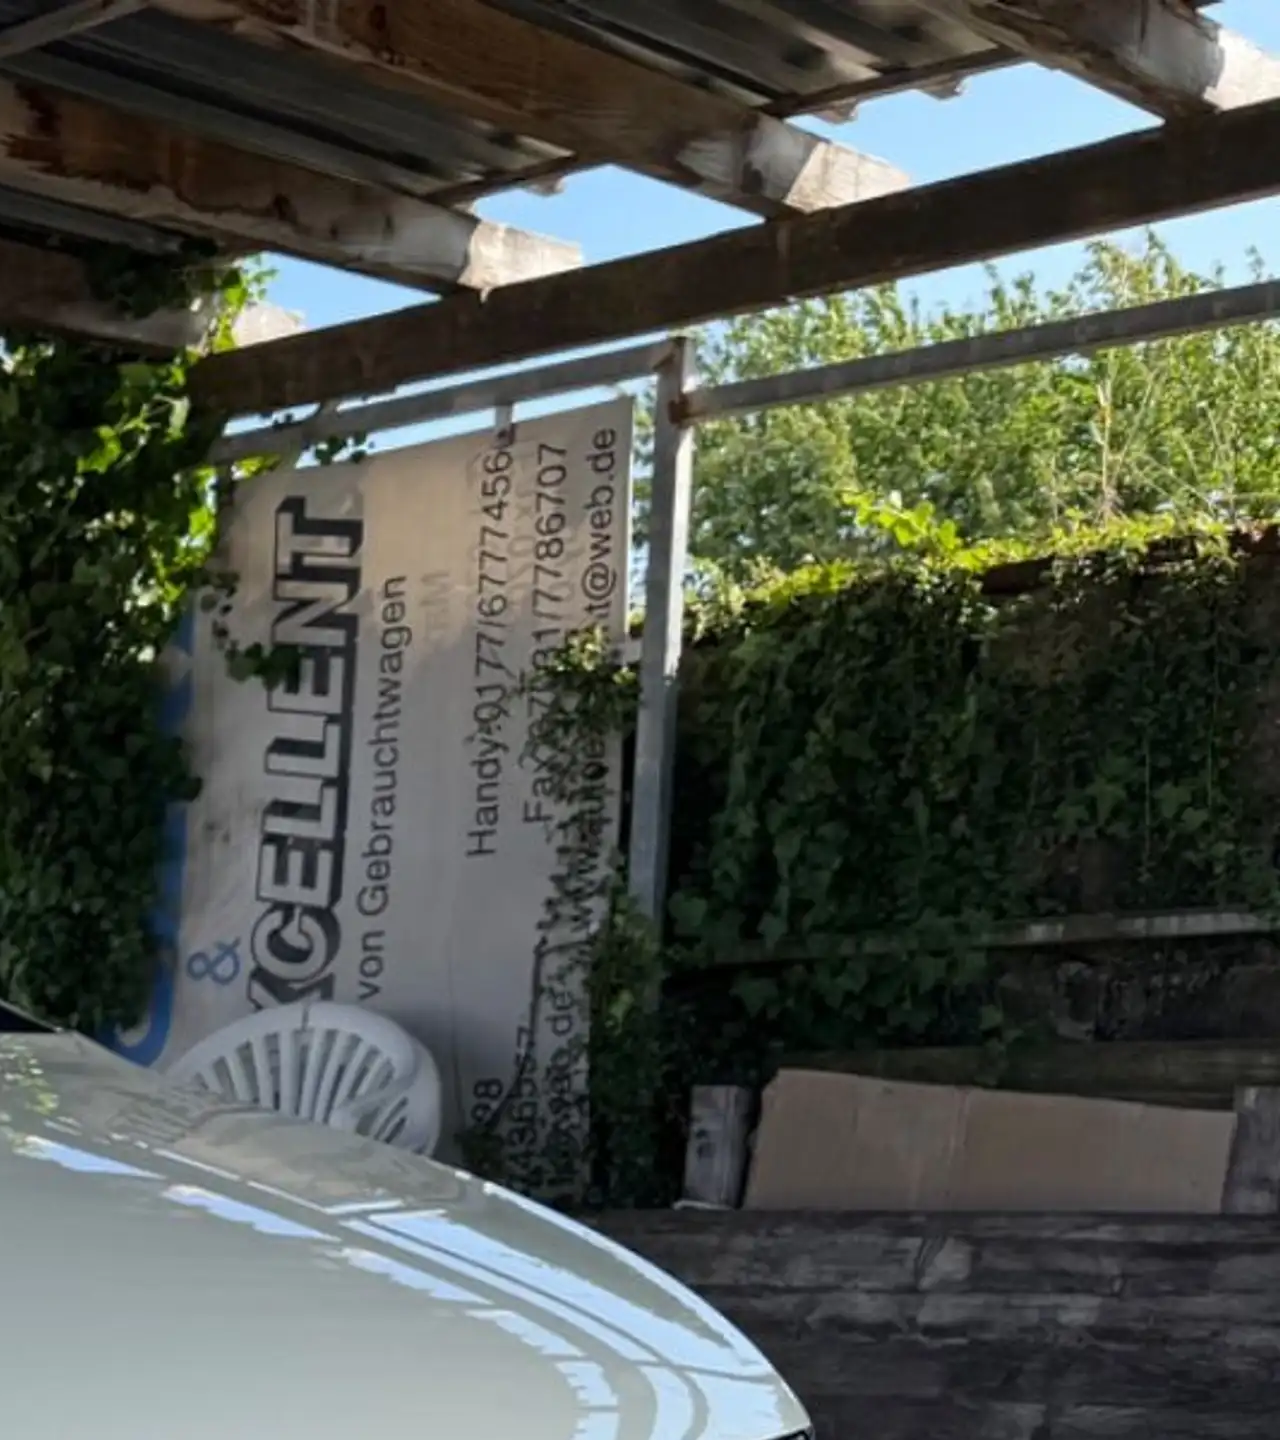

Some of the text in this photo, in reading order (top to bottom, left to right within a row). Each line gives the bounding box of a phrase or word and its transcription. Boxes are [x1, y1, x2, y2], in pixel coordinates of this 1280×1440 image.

[356, 575, 414, 1000] von Gebrauchtwagen
[186, 936, 241, 986] &
